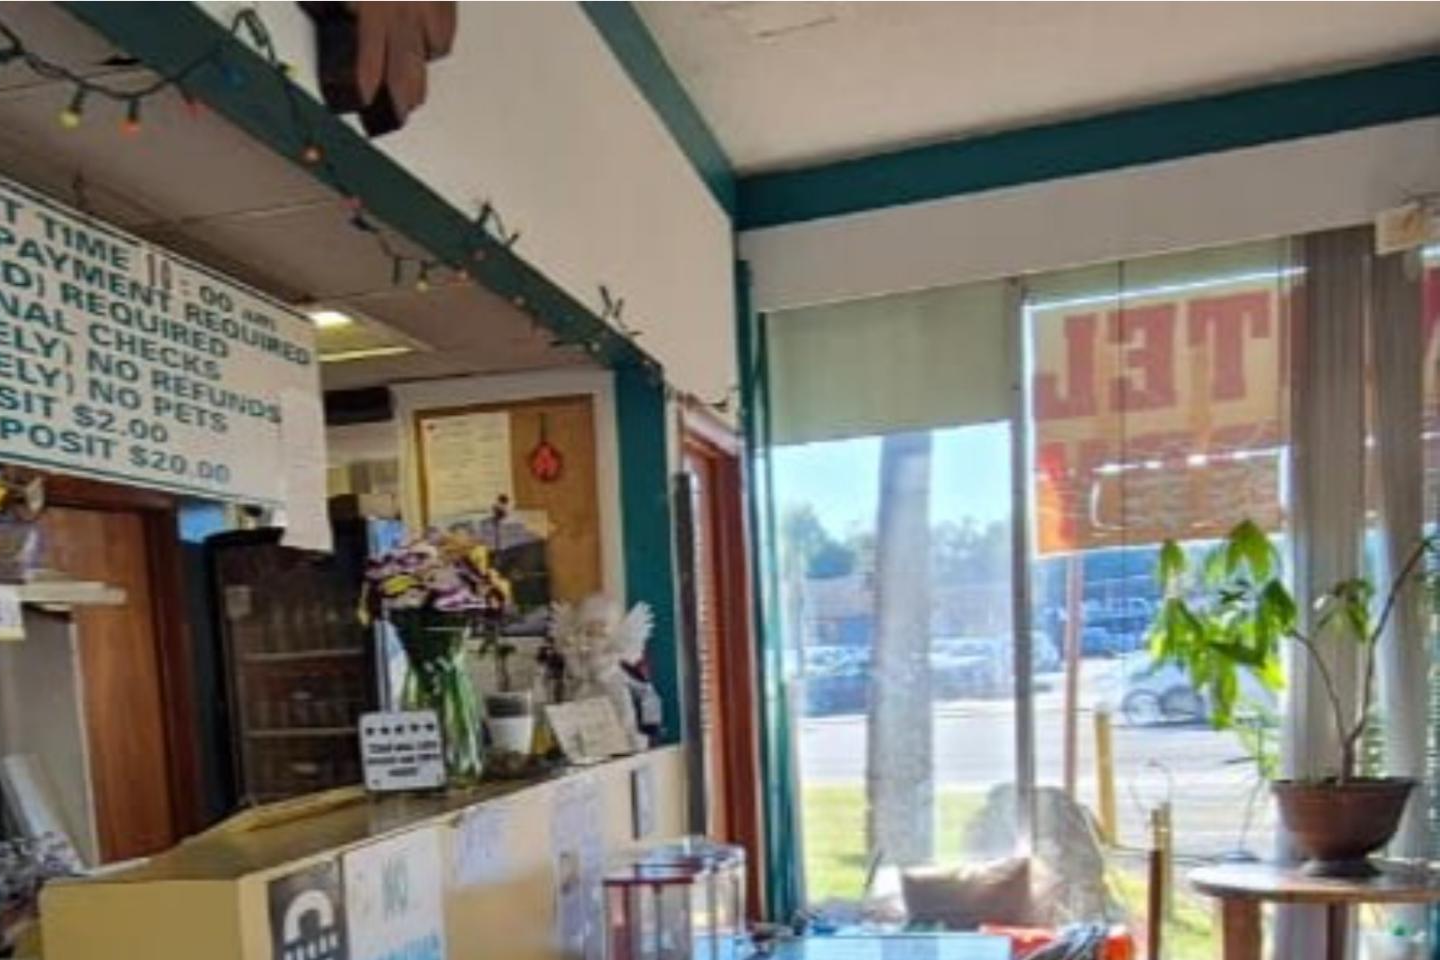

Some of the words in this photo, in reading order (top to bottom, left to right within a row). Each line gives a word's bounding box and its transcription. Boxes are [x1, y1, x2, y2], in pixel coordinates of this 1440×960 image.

[36, 211, 129, 271] TIME
[60, 281, 229, 358] REQUIRED
[184, 302, 310, 365] REQUIRED
[88, 322, 222, 381] CHECKS
[87, 349, 139, 383] NO
[151, 369, 282, 424] REFUNDS
[89, 378, 141, 411] NO
[154, 396, 228, 433] PETS
[73, 403, 168, 443] $2.00
[129, 445, 231, 483] $20.00
